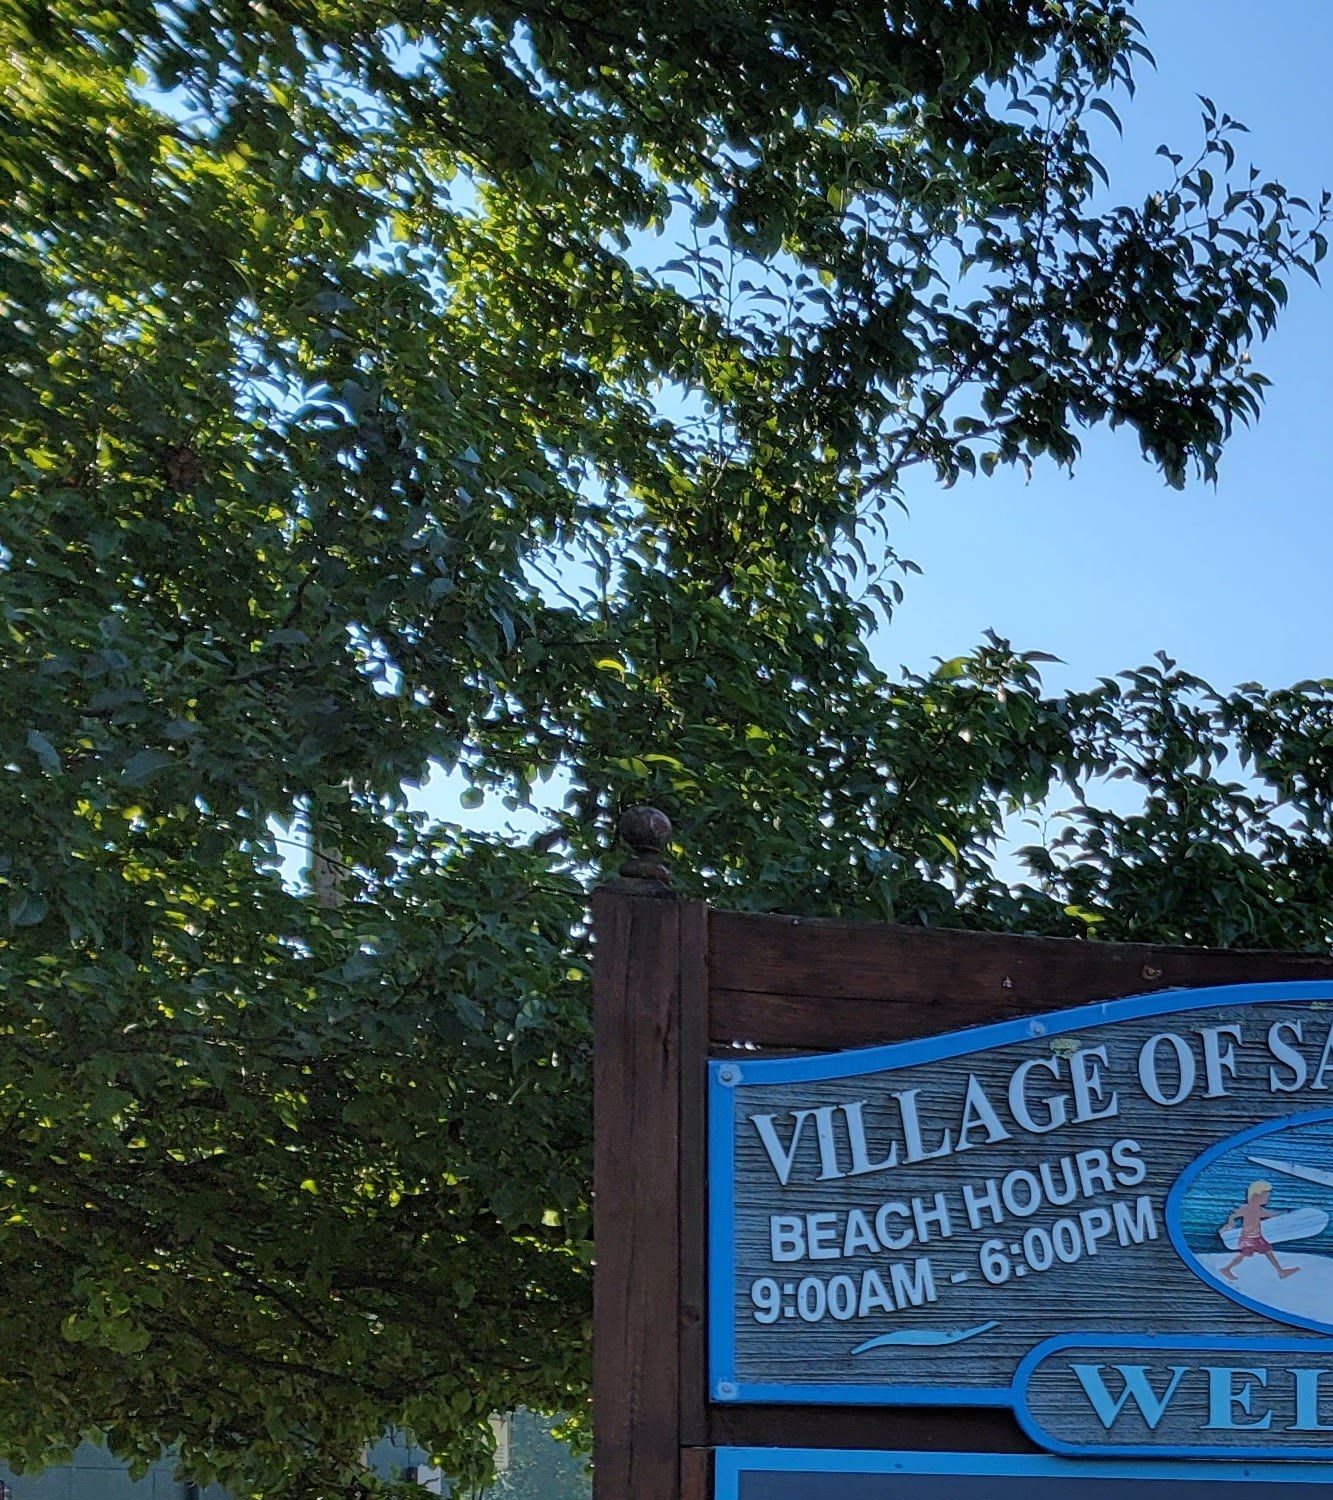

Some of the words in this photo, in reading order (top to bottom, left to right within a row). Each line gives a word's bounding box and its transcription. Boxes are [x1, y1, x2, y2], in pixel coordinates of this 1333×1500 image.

[748, 1044, 1119, 1187] VILLAGE
[1137, 1023, 1242, 1107] OF
[750, 1256, 939, 1325] 9:00AM
[950, 1270, 967, 1284] -
[979, 1195, 1159, 1285] 6:00PM
[769, 1192, 952, 1263] BEACH
[962, 1139, 1147, 1230] HOURS
